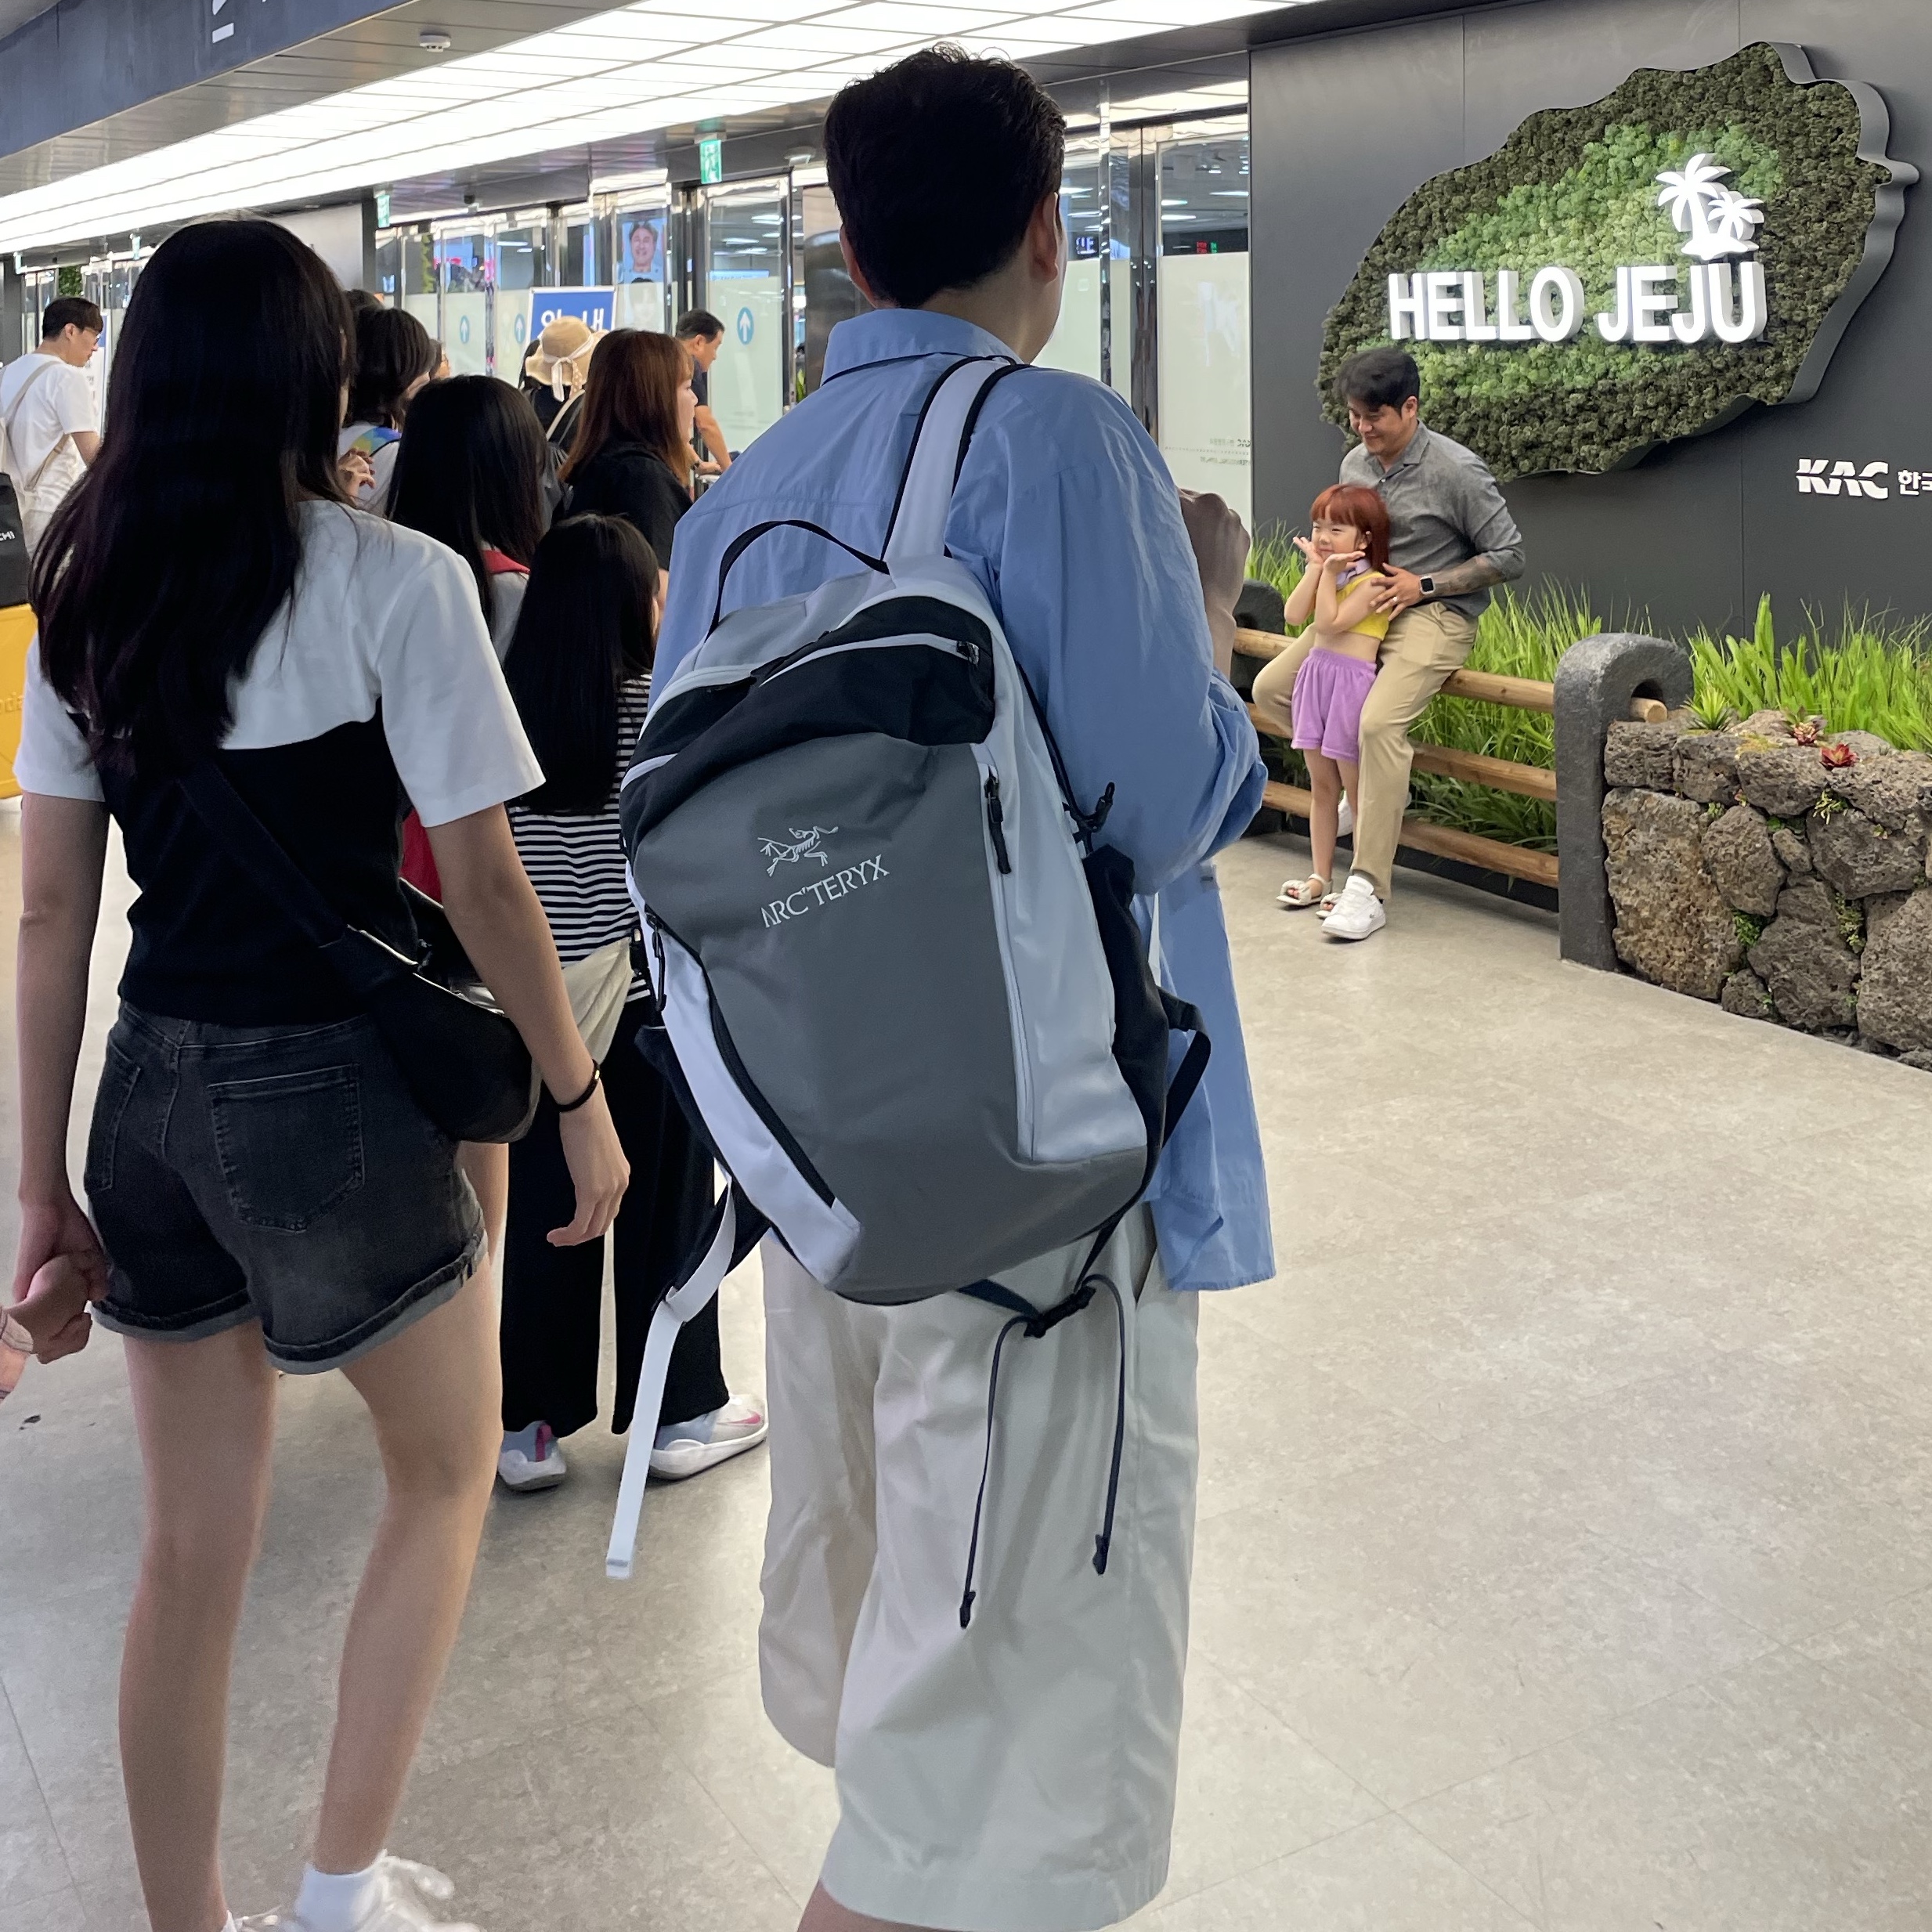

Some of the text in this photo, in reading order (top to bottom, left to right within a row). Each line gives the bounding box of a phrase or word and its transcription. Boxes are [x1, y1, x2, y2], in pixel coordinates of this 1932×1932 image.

[1389, 262, 1768, 344] HELLO JEJU
[1796, 458, 1888, 500] KAC
[760, 854, 890, 928] ARC'TERYX
